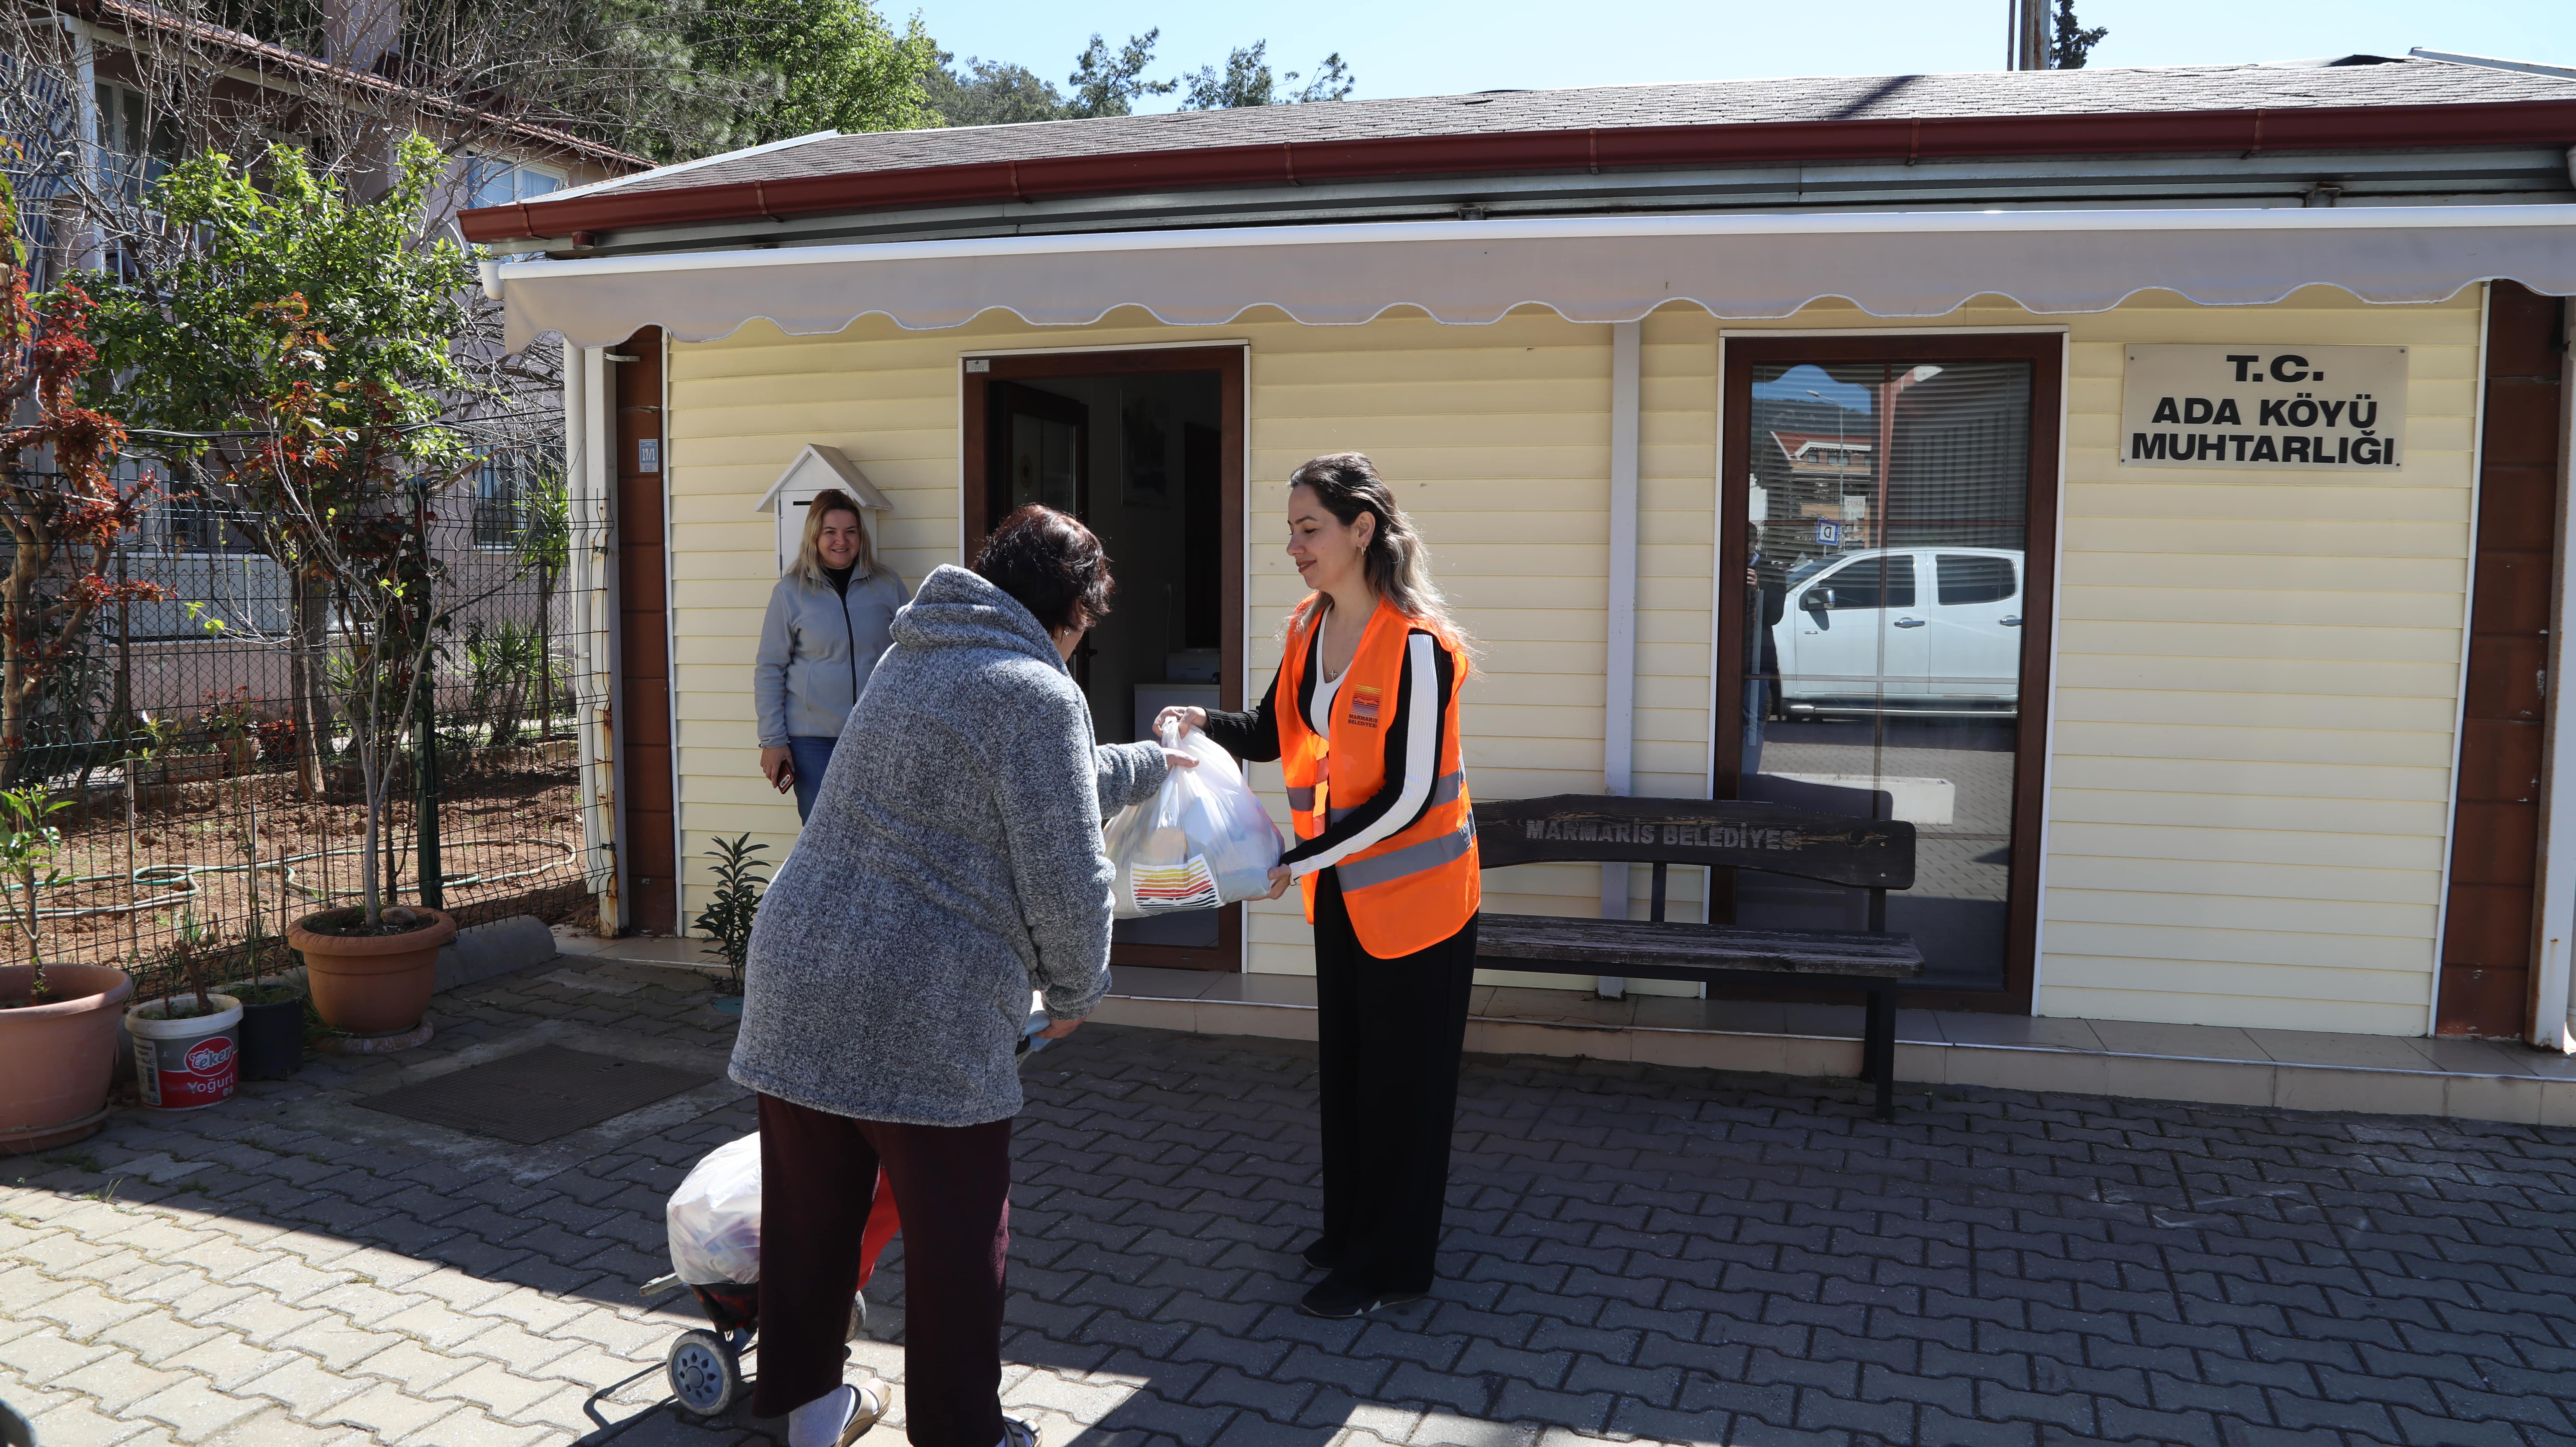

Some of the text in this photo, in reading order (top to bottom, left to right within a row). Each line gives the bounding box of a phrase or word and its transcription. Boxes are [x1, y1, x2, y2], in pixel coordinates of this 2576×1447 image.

[2226, 354, 2324, 382] T.C.
[2152, 392, 2377, 429] ADA KÖYÜ
[642, 448, 656, 461] 17/1
[2132, 430, 2394, 465] MUHTARLIĞI
[1348, 719, 1377, 728] BELEDİYESİ
[1349, 714, 1378, 723] MARMARİS
[1526, 817, 1655, 844] MARMARİS
[198, 1046, 232, 1069] eker
[187, 1072, 233, 1093] Yoğurt
